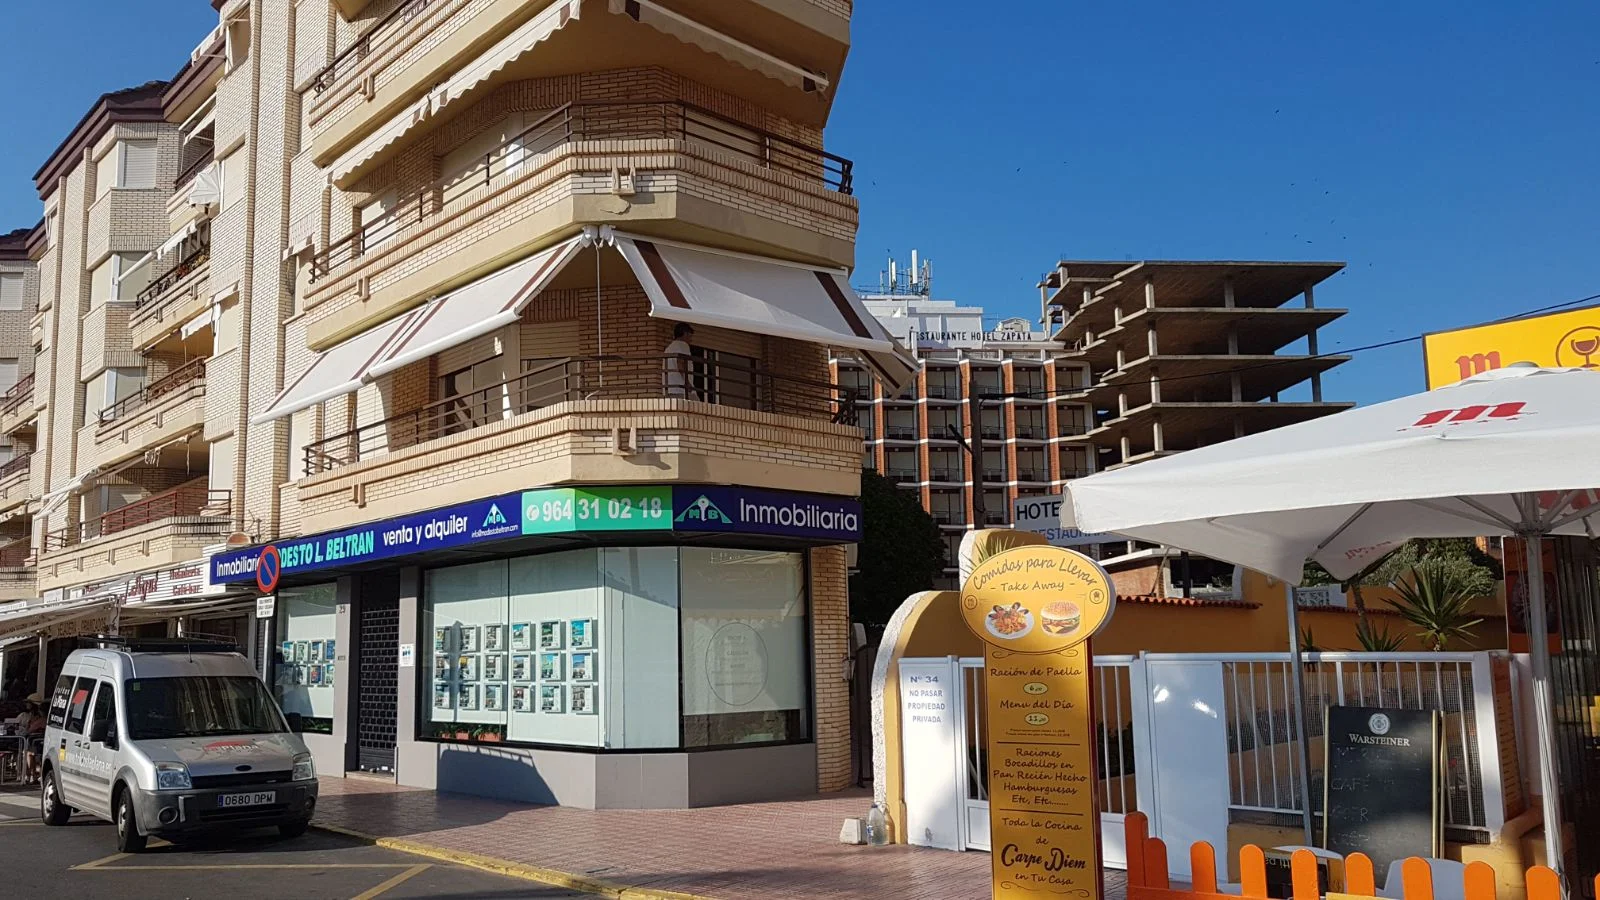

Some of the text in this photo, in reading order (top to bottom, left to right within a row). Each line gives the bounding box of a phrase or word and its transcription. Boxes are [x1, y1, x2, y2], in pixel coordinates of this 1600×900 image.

[1001, 331, 1032, 341] ZAPATA
[542, 497, 662, 522] 964 31 02 18
[740, 498, 857, 531] Inmobiliaria
[1016, 501, 1063, 521] HOTE
[278, 542, 313, 568] DESTO
[315, 541, 324, 563] L.
[326, 530, 374, 561] BELTRAN
[383, 525, 413, 546] venta
[415, 524, 423, 544] y
[425, 515, 468, 540] alquiler
[973, 557, 1098, 590] Comidas para Llevar
[1001, 581, 1065, 592] Take Away
[990, 667, 1081, 677] Ración de Paella
[908, 702, 946, 710] PROPIEDAD
[1000, 700, 1031, 709] Menu
[1032, 700, 1050, 708] del
[912, 715, 942, 723] PRIVADA
[1349, 733, 1411, 747] WARSTEINER
[1015, 748, 1062, 758] Raciones
[1005, 759, 1057, 769] Bocadillos
[993, 770, 1087, 782] Pan Recién Hecho
[1003, 782, 1078, 795] Hamburguesas
[225, 793, 273, 805] 0680 DPM
[1012, 795, 1031, 805] Etc,
[1002, 817, 1082, 830] Toda la Cocina
[1036, 836, 1050, 845] de
[1001, 843, 1086, 871] Carpe Diem
[1031, 874, 1046, 882] Tu
[1049, 875, 1074, 885] Casa
